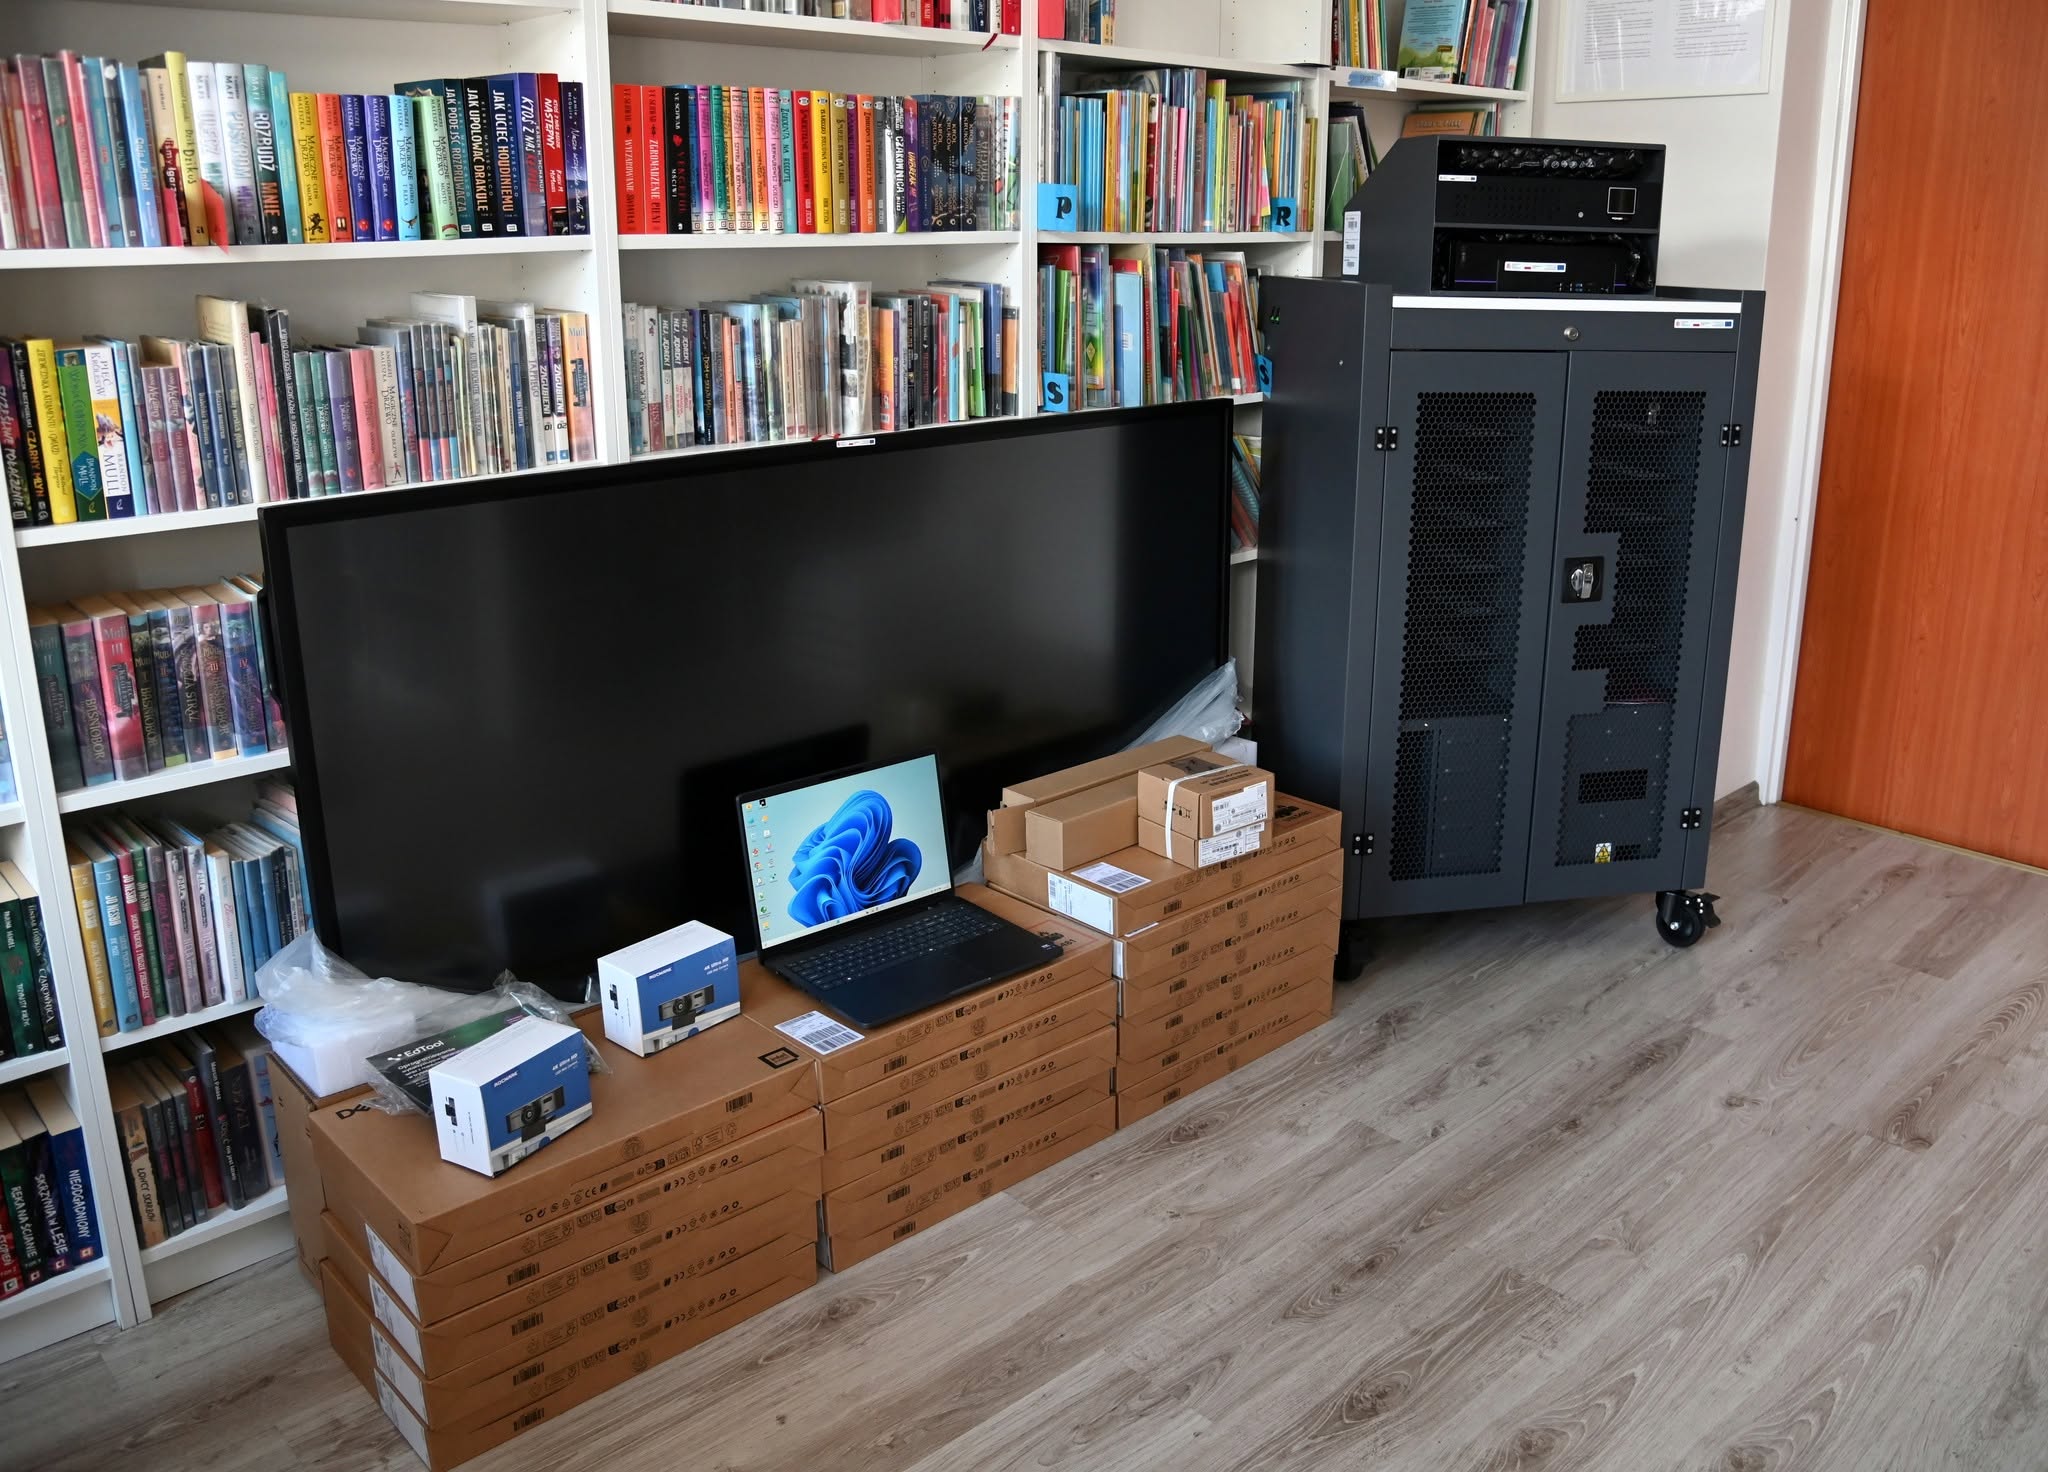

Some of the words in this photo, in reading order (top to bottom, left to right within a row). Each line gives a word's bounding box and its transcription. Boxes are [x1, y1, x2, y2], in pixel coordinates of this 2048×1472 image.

[467, 88, 478, 107] JAK
[493, 90, 506, 110] JAK
[495, 114, 508, 142] UCIEC
[525, 135, 536, 152] NAS
[183, 149, 198, 184] Dzikus
[298, 139, 310, 176] DRZEWO
[306, 136, 318, 180] MAGICZNE
[347, 140, 358, 176] DRZEWO
[354, 137, 365, 180] MAGICZNE
[372, 140, 383, 177] DRZEWO
[380, 137, 390, 180] MAGICZNE
[396, 140, 407, 176] DRZEWO
[404, 137, 413, 180] MAGICZNE
[432, 140, 443, 176] DRZEWO
[438, 137, 450, 179] MAGICZNE
[445, 88, 457, 105] JAK
[451, 148, 467, 212] ROZPRUWACZA
[497, 146, 513, 211] HOUDINIEMU
[649, 140, 661, 199] ZGROMADZENIE
[908, 152, 917, 186] UNBREAK
[260, 182, 280, 216] MNIE
[1056, 196, 1073, 220] P
[1276, 206, 1292, 227] R
[287, 383, 297, 414] PRZYJACIEL
[387, 386, 398, 427] MAGICZNE
[540, 365, 551, 414] ZAGUBIENI
[554, 364, 564, 413] ZAGUBIENI
[1047, 381, 1064, 404] S
[381, 390, 391, 425] DRZEWO
[27, 431, 41, 469] CZARNY
[103, 454, 120, 496] MULL
[105, 896, 117, 904] JO
[38, 968, 55, 1022] CZAROWNICA
[404, 1040, 445, 1058] EdTool
[336, 1103, 371, 1120] DE
[16, 1210, 29, 1222] NA
[34, 1174, 57, 1218] SKRZYNIA
[49, 1228, 69, 1255] LESIE
[68, 1170, 91, 1238] NIEODGADNIONY
